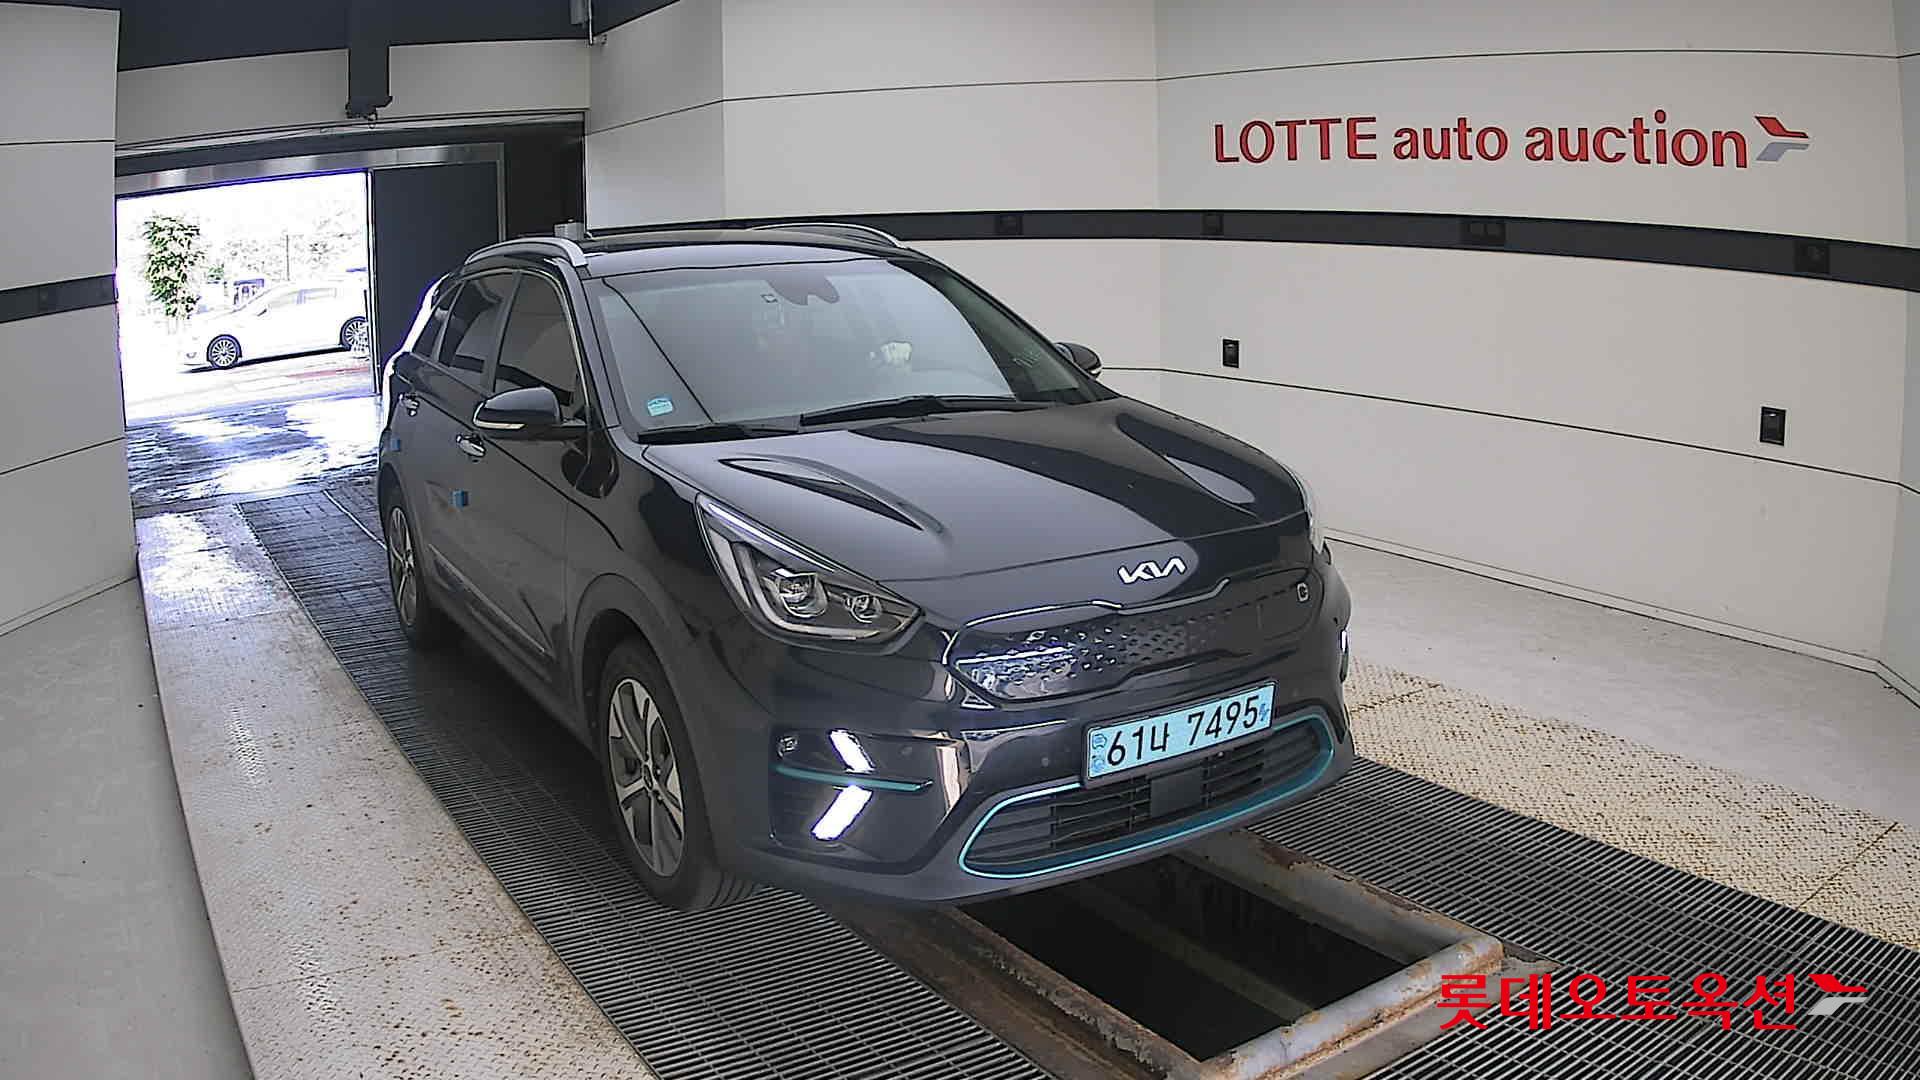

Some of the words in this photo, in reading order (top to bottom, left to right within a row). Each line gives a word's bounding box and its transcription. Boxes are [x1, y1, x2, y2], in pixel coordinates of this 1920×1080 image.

[1214, 117, 1378, 163] LOTTE
[1393, 116, 1509, 161] auto
[1524, 109, 1749, 169] auction
[1106, 722, 1170, 767] 61나
[1187, 694, 1260, 747] 7495
